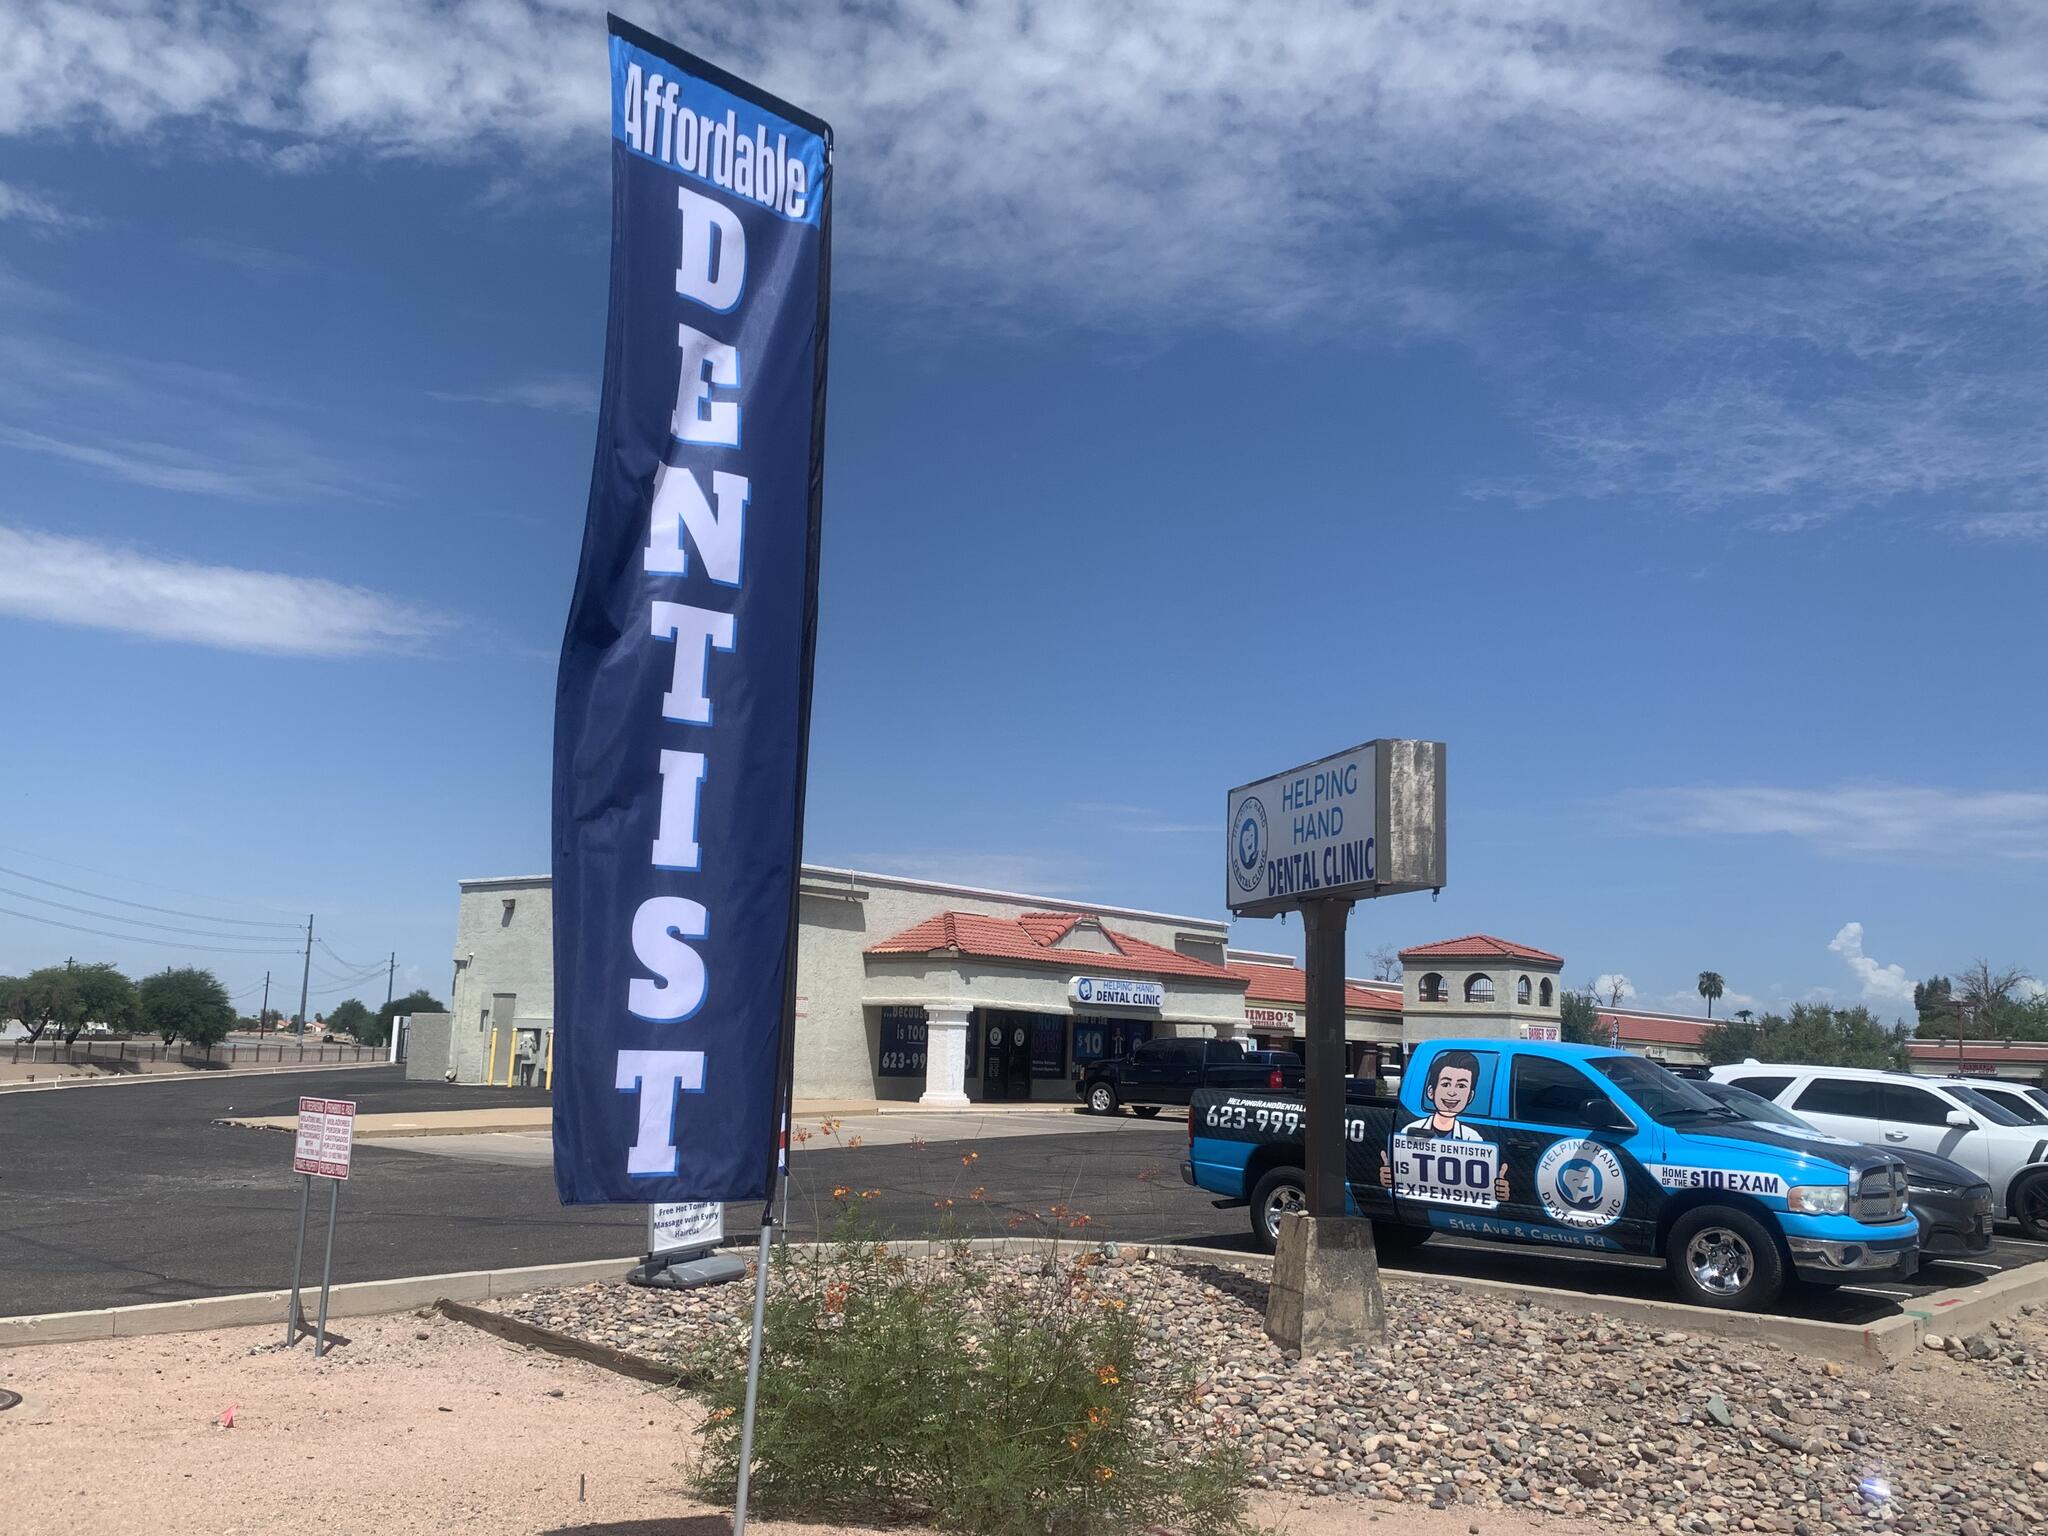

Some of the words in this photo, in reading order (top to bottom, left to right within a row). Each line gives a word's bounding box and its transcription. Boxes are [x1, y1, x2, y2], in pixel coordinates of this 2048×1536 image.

[625, 61, 807, 218] Affordable
[615, 186, 748, 1178] DENTIST
[1282, 764, 1358, 812] HELPING
[1293, 806, 1344, 845] HAND
[1268, 852, 1320, 896] DENTAL
[1323, 837, 1374, 886] CLINIC
[1096, 990, 1131, 1004] DENTAL
[1133, 993, 1160, 1006] CLINIC
[1103, 981, 1133, 992] HELPING
[1136, 984, 1155, 993] HAND
[896, 1024, 905, 1040] is
[907, 1025, 926, 1041] TOO
[1394, 1138, 1437, 1152] BECAUSE
[1440, 1144, 1493, 1158] DENTISTRY
[1541, 1141, 1591, 1171] HELPING
[1592, 1143, 1620, 1178] HAND
[1395, 1161, 1409, 1175] IS
[1412, 1153, 1490, 1189] TOO
[1662, 1166, 1688, 1178] HOME
[1662, 1177, 1671, 1186] OF
[1674, 1178, 1688, 1187] THE
[1690, 1170, 1724, 1189] $10
[1728, 1173, 1779, 1194] EXAM
[1395, 1182, 1492, 1206] EXPENSIVE
[654, 1218, 683, 1230] Massage
[684, 1214, 700, 1224] with
[701, 1211, 719, 1221] Every
[659, 1208, 674, 1216] Free
[675, 1205, 687, 1213] Hot
[1541, 1191, 1583, 1227] DENTAL
[1585, 1198, 1621, 1227] CLINIC
[1449, 1218, 1477, 1231] 51st
[1482, 1223, 1509, 1236] Ave
[1514, 1226, 1526, 1237] &
[1530, 1229, 1580, 1245] Cactus
[1584, 1234, 1606, 1248] Rd
